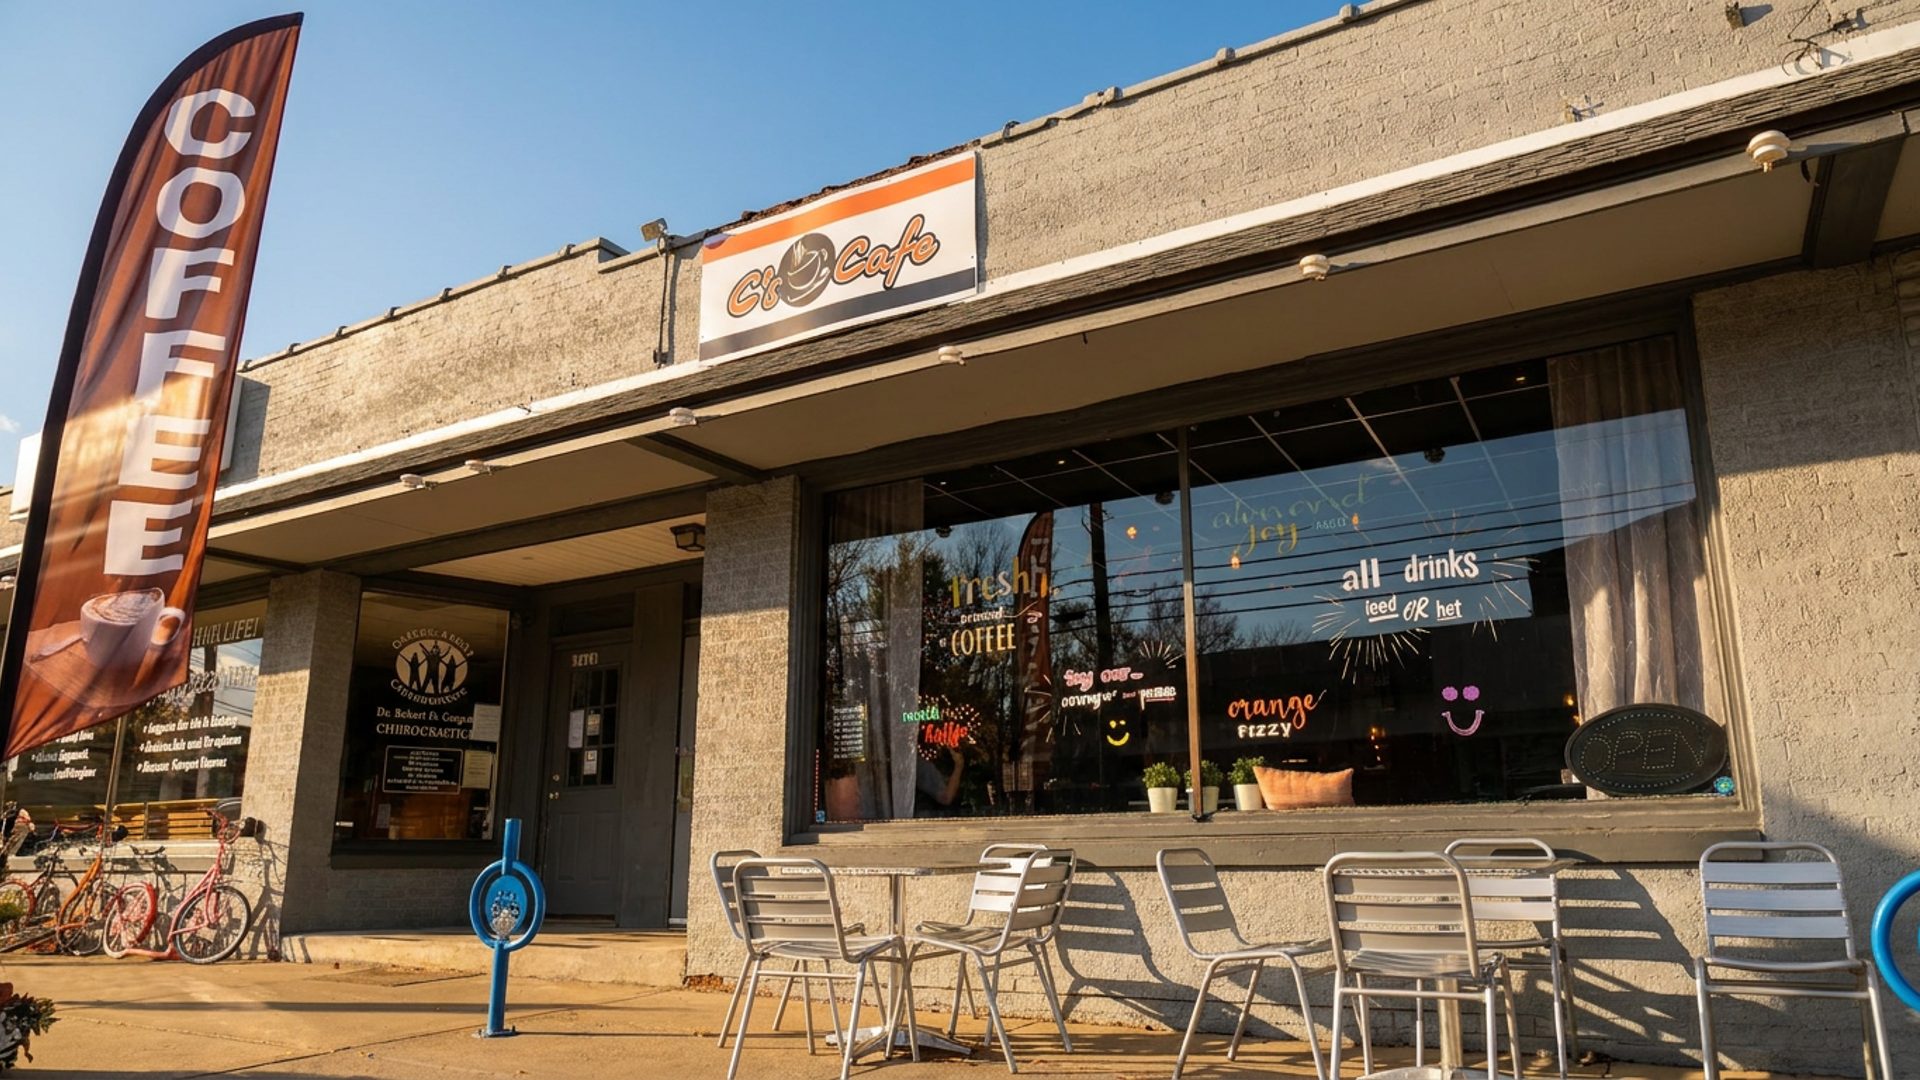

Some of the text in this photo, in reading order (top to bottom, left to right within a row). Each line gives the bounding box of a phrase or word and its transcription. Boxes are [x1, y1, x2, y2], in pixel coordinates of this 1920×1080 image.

[727, 214, 940, 317] C's Cafe
[103, 88, 256, 576] COFFEE
[1342, 548, 1480, 592] all drinks
[1402, 596, 1430, 622] OR
[951, 623, 1017, 657] COFFEE
[1228, 689, 1327, 730] orange
[1579, 727, 1705, 775] OPEN
